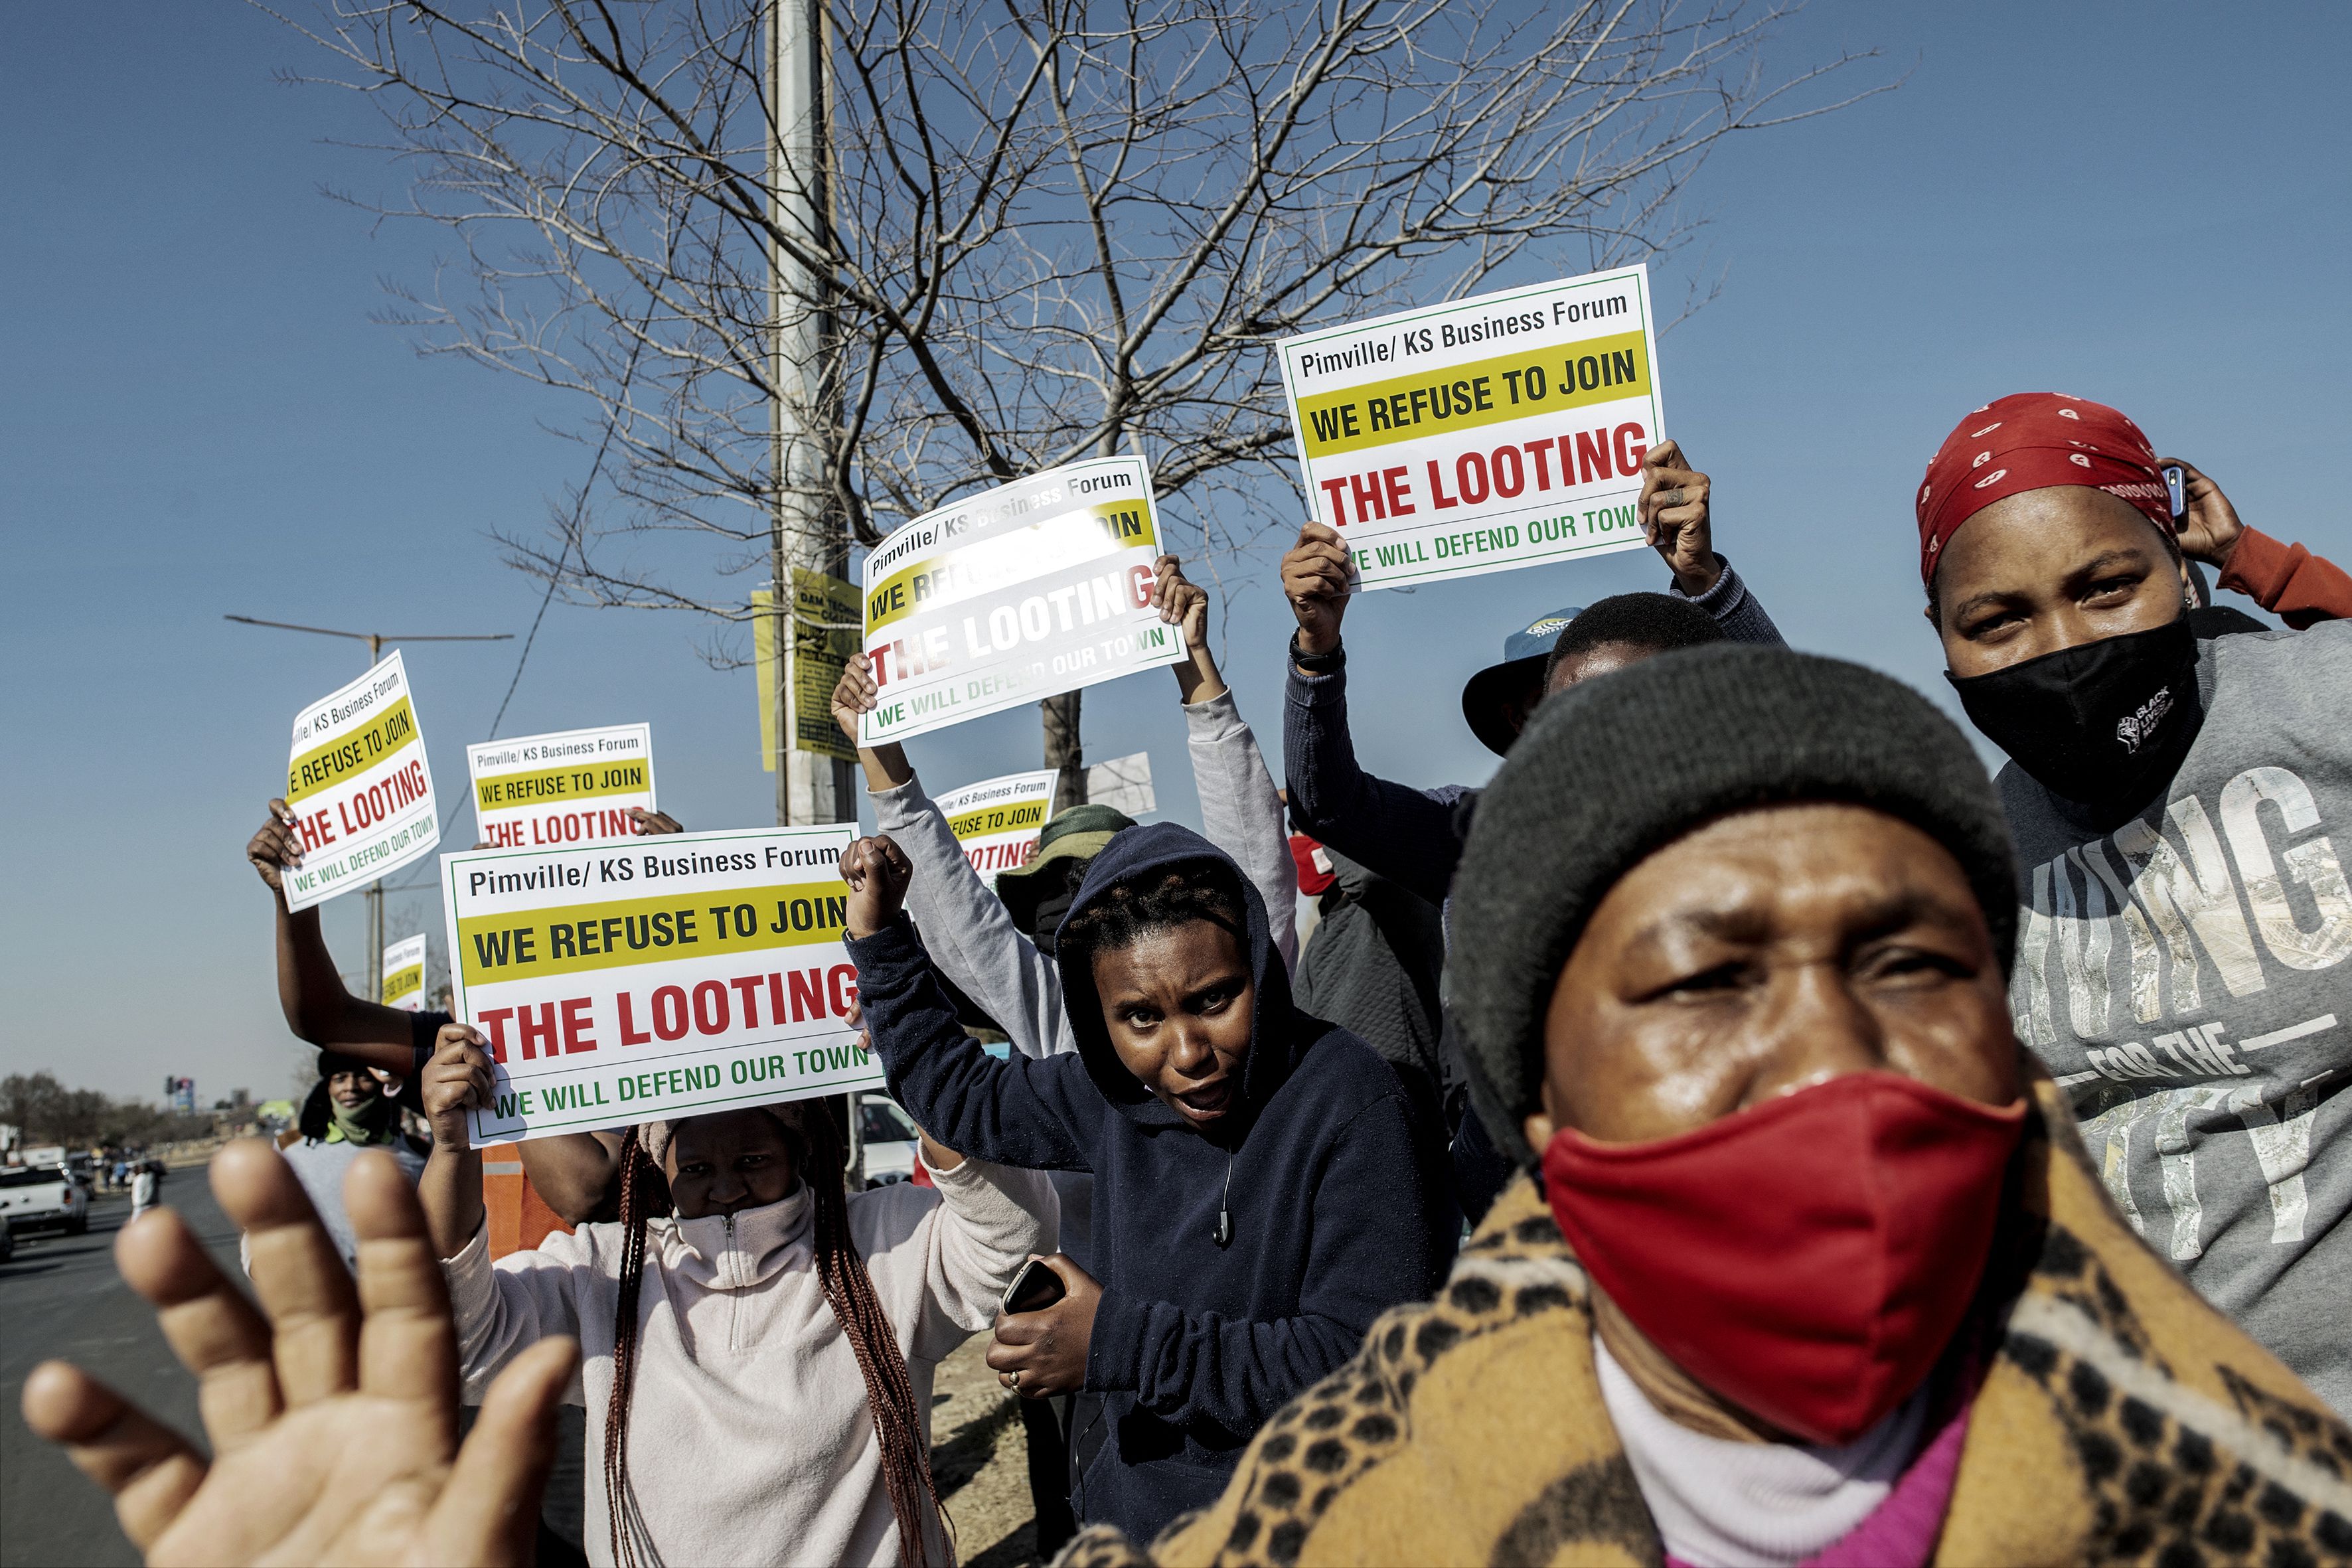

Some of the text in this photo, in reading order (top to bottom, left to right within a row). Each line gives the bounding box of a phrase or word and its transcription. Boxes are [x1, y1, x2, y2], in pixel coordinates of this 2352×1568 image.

[1300, 295, 1628, 378] Pimville/ KS Business Forum
[1310, 349, 1637, 443] WE REFUSE TO JOIN
[1320, 422, 1648, 527] THE LOOTING
[872, 472, 1132, 578] Pimville/ KS Business Forum
[1380, 541, 1429, 568] WILL
[1435, 525, 1520, 560] DEFEND
[1528, 515, 1577, 540] OUR
[1582, 504, 1636, 534] TOW
[868, 564, 1154, 688] THE LOOTING
[871, 582, 905, 622] WE
[314, 713, 329, 733] KS
[331, 691, 374, 724] Business
[372, 672, 399, 700] Forum
[876, 702, 906, 729] WE
[911, 687, 962, 717] WILL
[1052, 647, 1097, 674] OUR
[1101, 627, 1166, 659] TOWN
[2136, 686, 2169, 719] BLACK
[2140, 700, 2165, 729] LIVES
[287, 709, 410, 796] E REFUSE TO JOIN
[477, 738, 639, 767] Pimville/ KS Business Forum
[481, 767, 642, 803] WE REFUSE TO JOIN
[288, 759, 427, 852] HE LOOTING
[949, 807, 1042, 835] FUSE TO JOIN
[958, 794, 970, 807] KS
[972, 786, 1012, 803] Business
[1014, 781, 1046, 794] Forum
[295, 814, 434, 892] WE WILL DEFEND OUR TOWN
[485, 820, 525, 848] THE
[469, 844, 840, 897] Pimville/ KS Business Forum
[473, 895, 848, 969] WE REFUSE TO JOIN
[478, 963, 859, 1064] THE LOOTING
[494, 1044, 870, 1120] WE WILL DEFEND OUR TOWN
[2086, 1021, 2251, 1081] FOR THE
